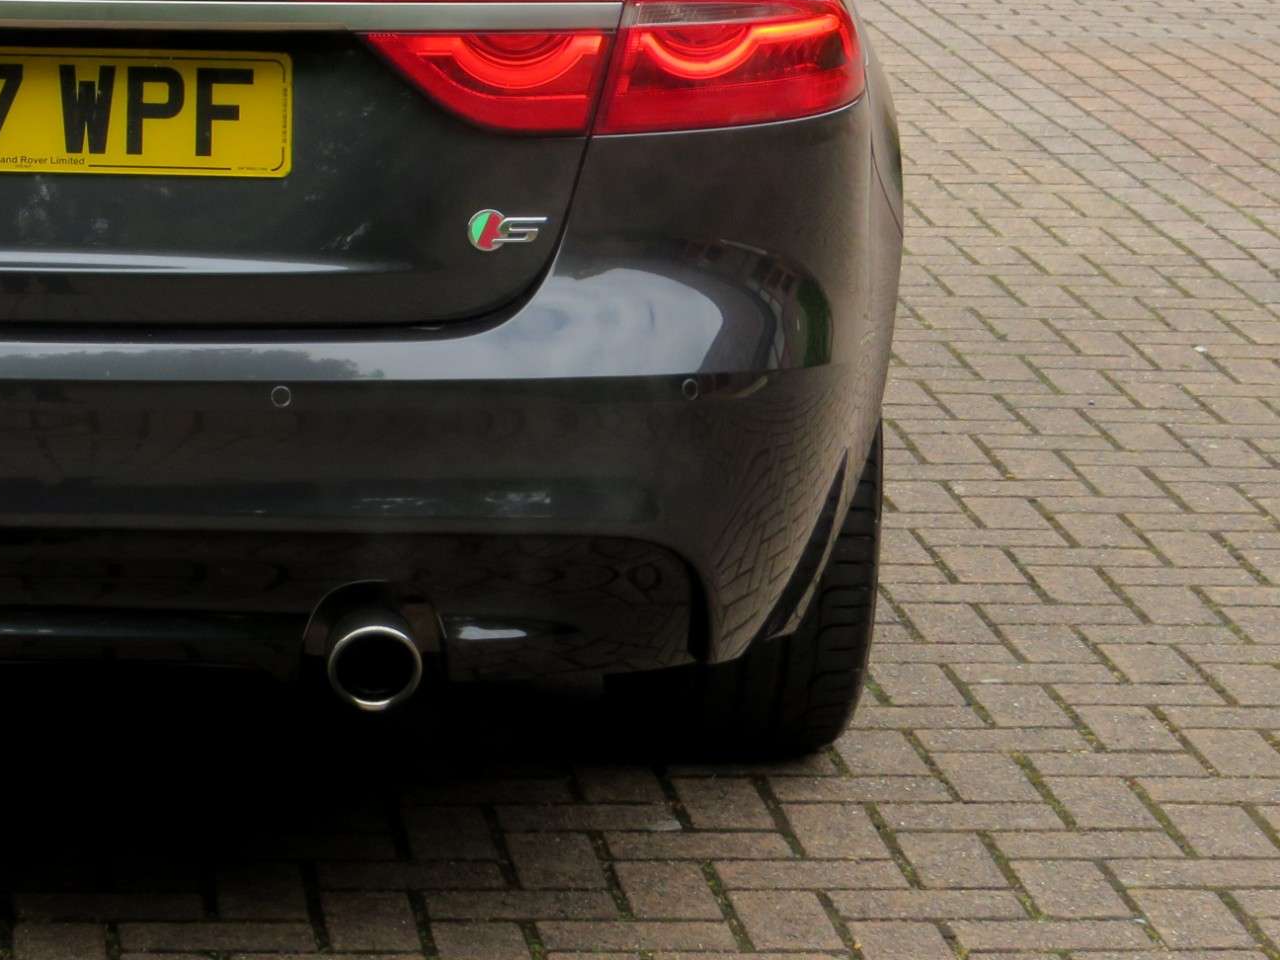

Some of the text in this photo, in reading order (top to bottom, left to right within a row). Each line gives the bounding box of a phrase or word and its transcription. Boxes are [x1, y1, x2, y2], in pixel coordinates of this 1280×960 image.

[58, 64, 254, 156] WPF
[20, 155, 48, 165] Rover
[50, 156, 86, 166] Limited
